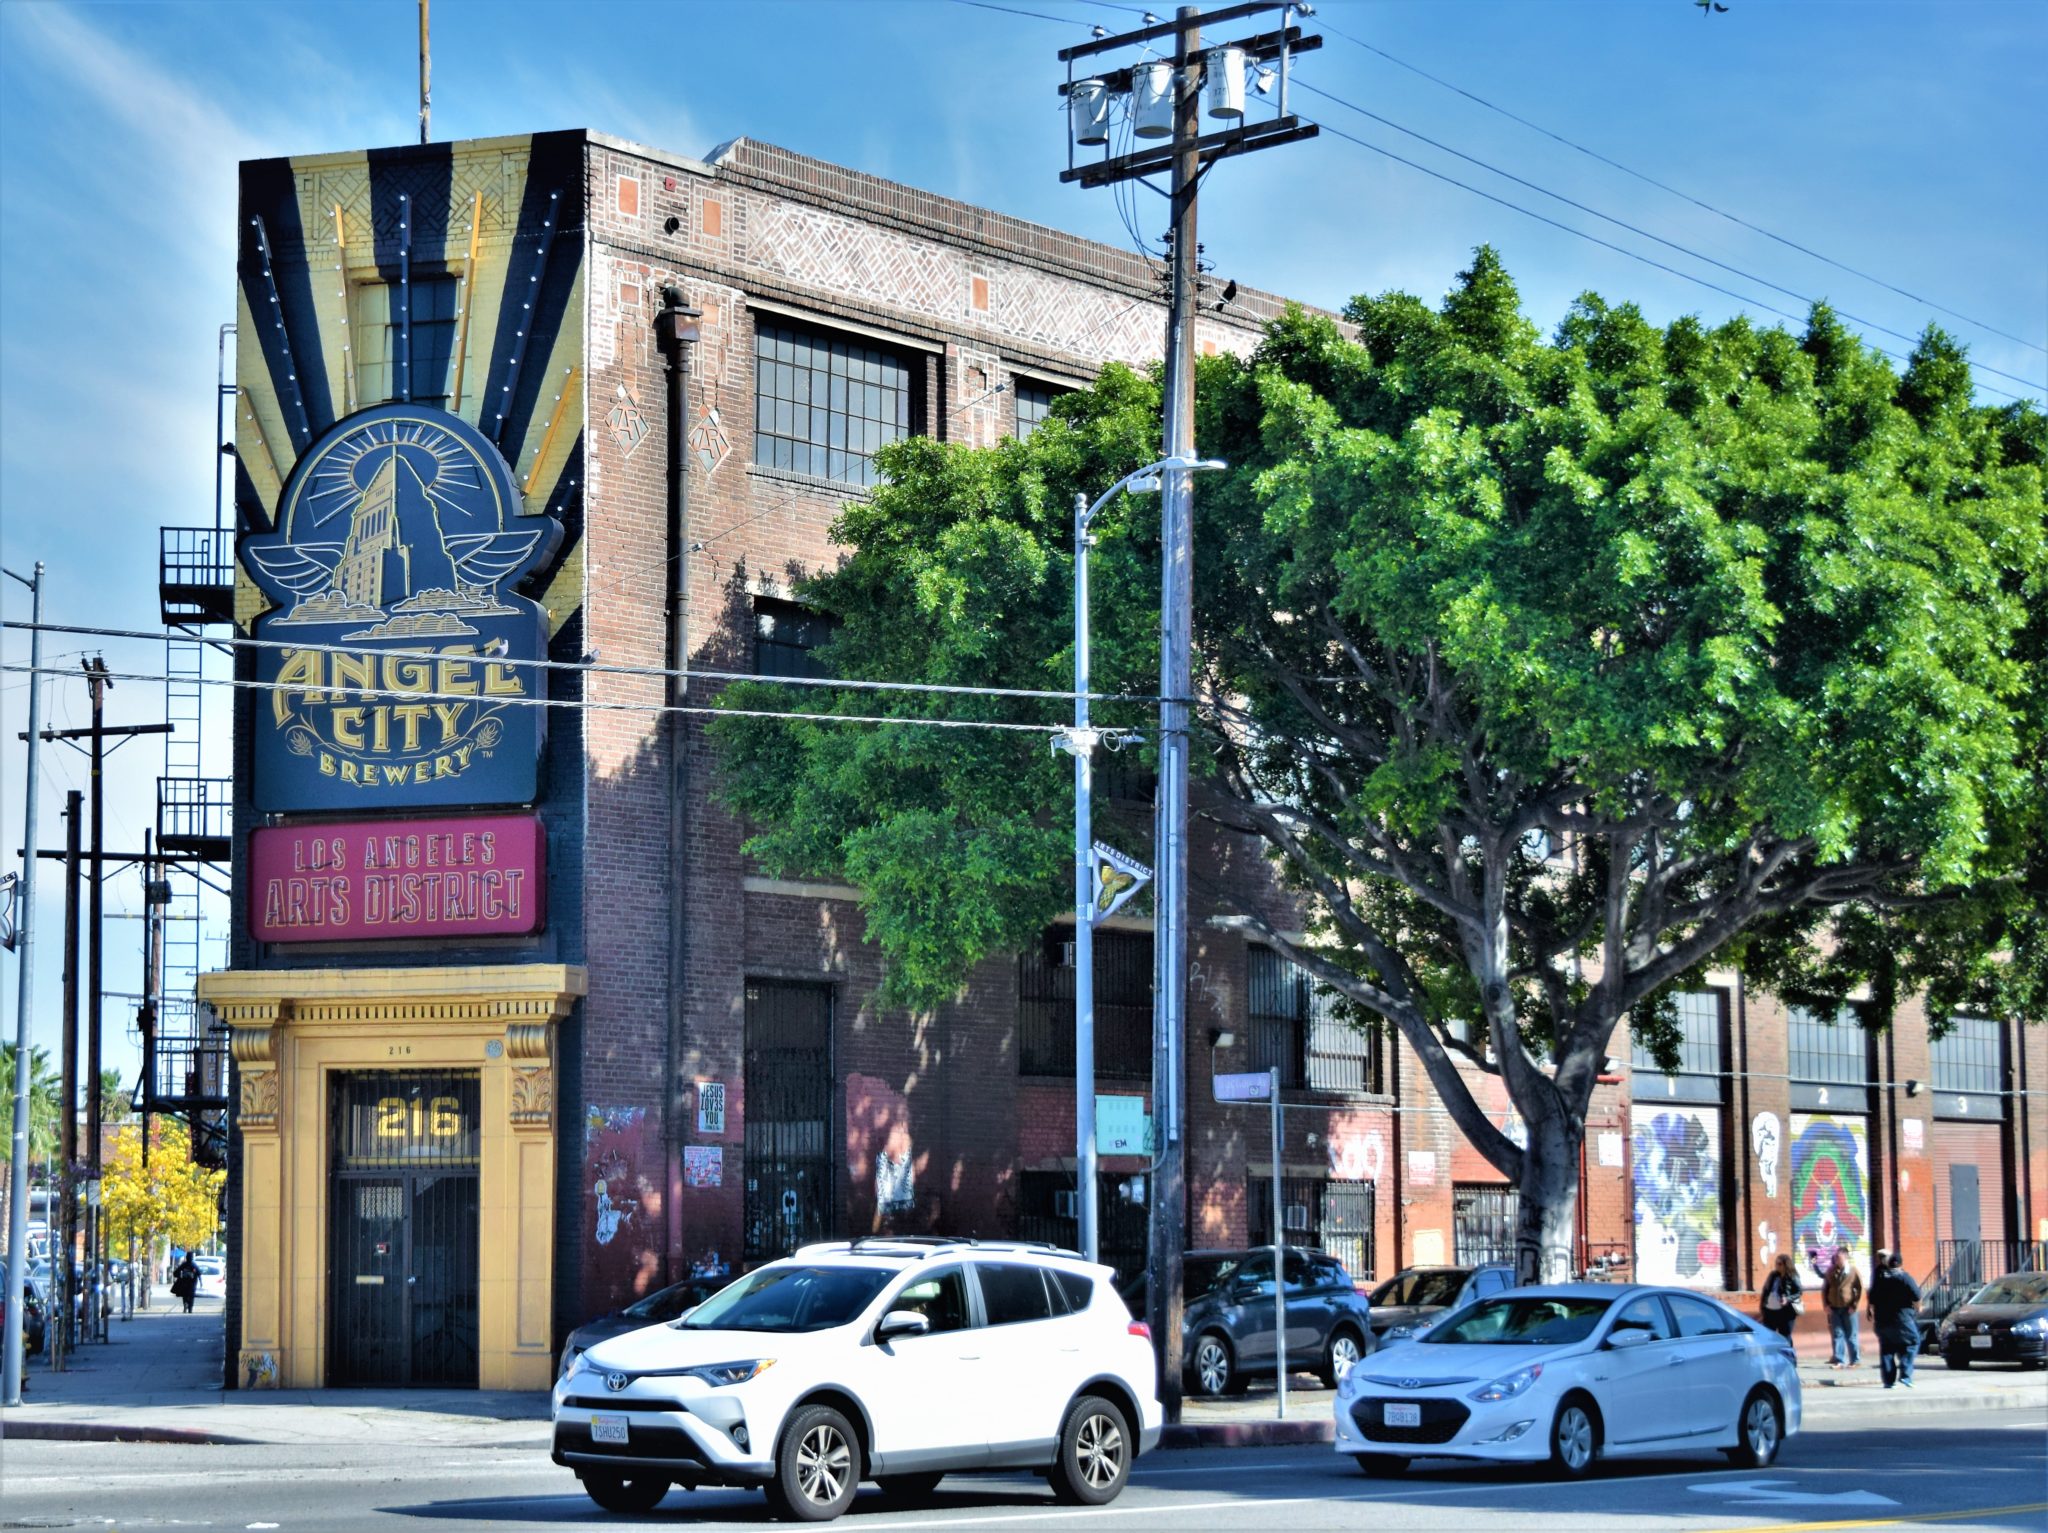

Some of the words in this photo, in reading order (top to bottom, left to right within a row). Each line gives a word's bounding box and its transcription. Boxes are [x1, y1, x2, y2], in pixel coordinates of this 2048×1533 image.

[271, 637, 527, 730] ANGEL
[332, 702, 469, 752] CITY
[319, 742, 475, 787] BREWERY
[294, 837, 347, 872] LOS
[364, 831, 496, 869] ANGELES
[1094, 840, 1115, 855] ARTS
[1115, 851, 1154, 876] DISTRICT
[264, 875, 351, 928] ARTS
[363, 868, 525, 924] DISTRICT
[389, 1046, 411, 1055] 216
[701, 1085, 723, 1098] JESUS
[1668, 1077, 1675, 1096] 1
[1818, 1087, 1829, 1104] 2
[378, 1097, 459, 1136] 216
[705, 1111, 719, 1125] YOU
[1957, 1096, 1968, 1113] 3
[593, 1424, 626, 1439] 7SHU250
